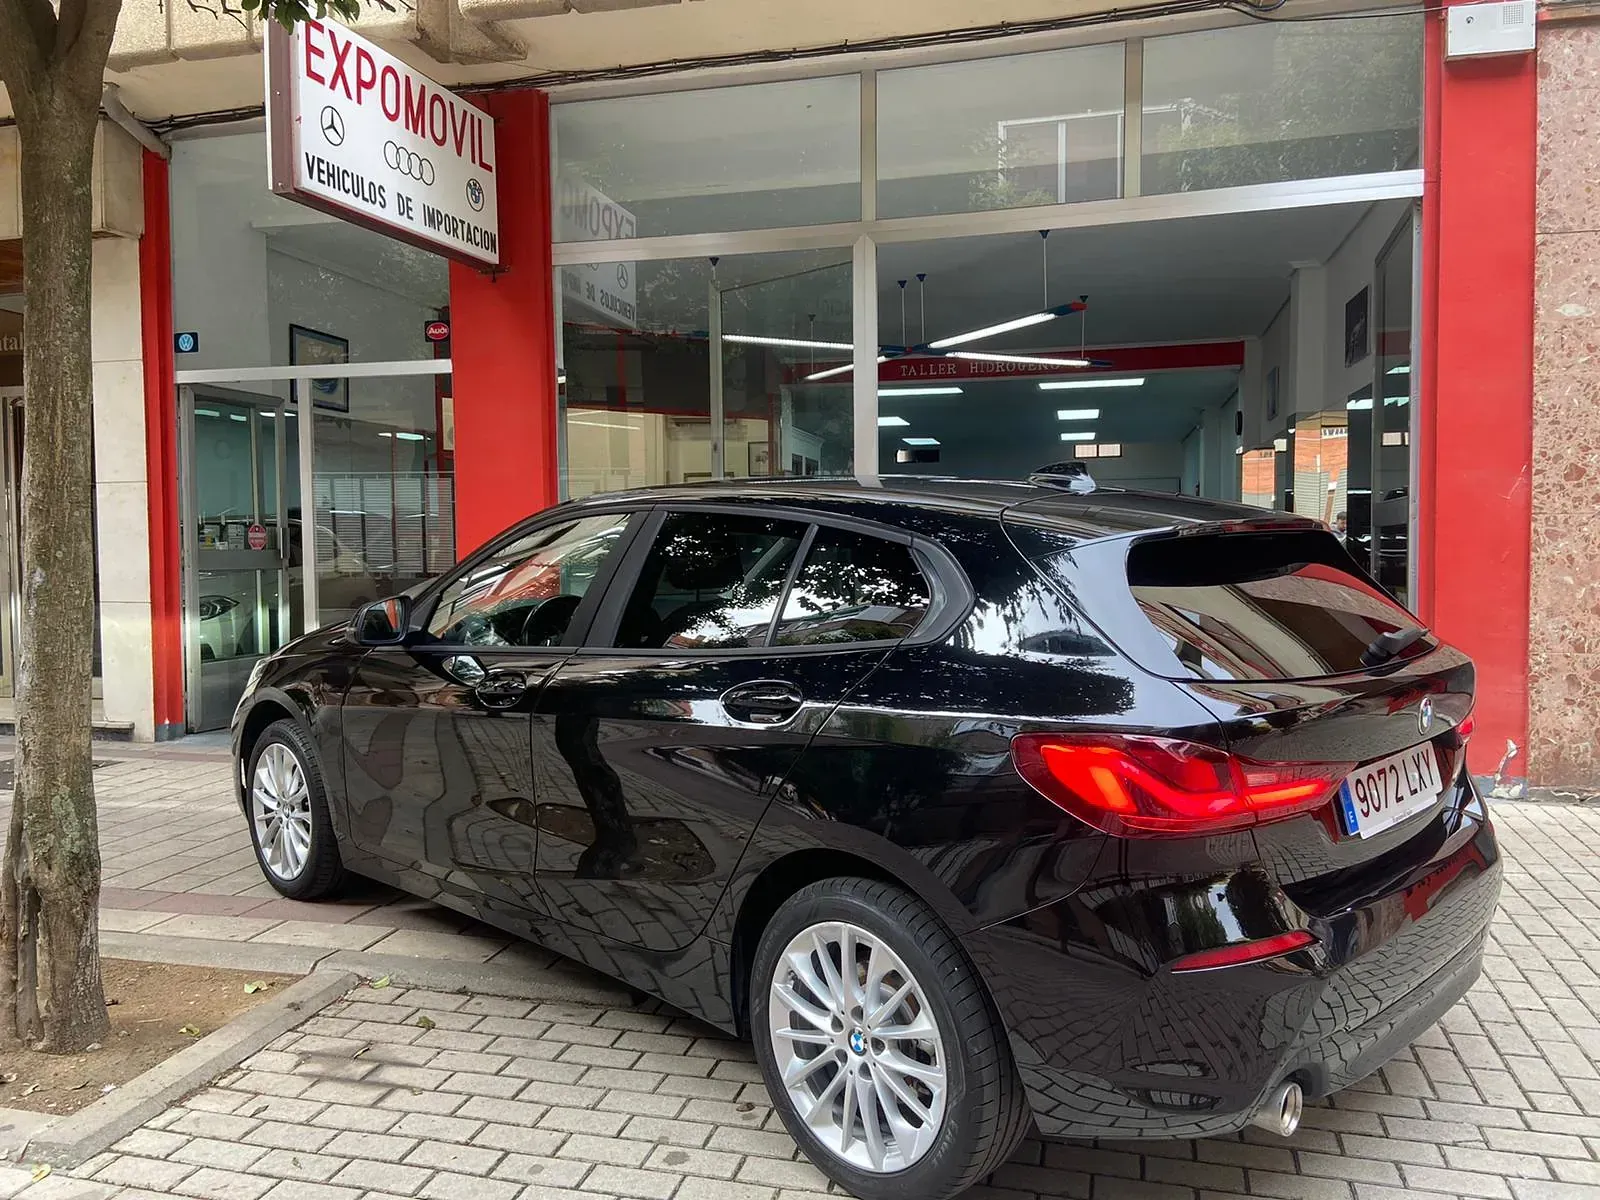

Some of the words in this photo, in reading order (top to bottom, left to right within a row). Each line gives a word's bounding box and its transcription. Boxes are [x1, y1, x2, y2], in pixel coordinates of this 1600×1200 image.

[305, 19, 493, 173] EXPOMOVIL
[305, 152, 387, 209] VEHICULOS
[397, 192, 414, 221] DE
[423, 203, 498, 255] IMPORTACION
[428, 326, 448, 335] Audi
[901, 363, 957, 377] TALLER
[1355, 763, 1405, 818] 9072
[1402, 748, 1434, 797] LXY
